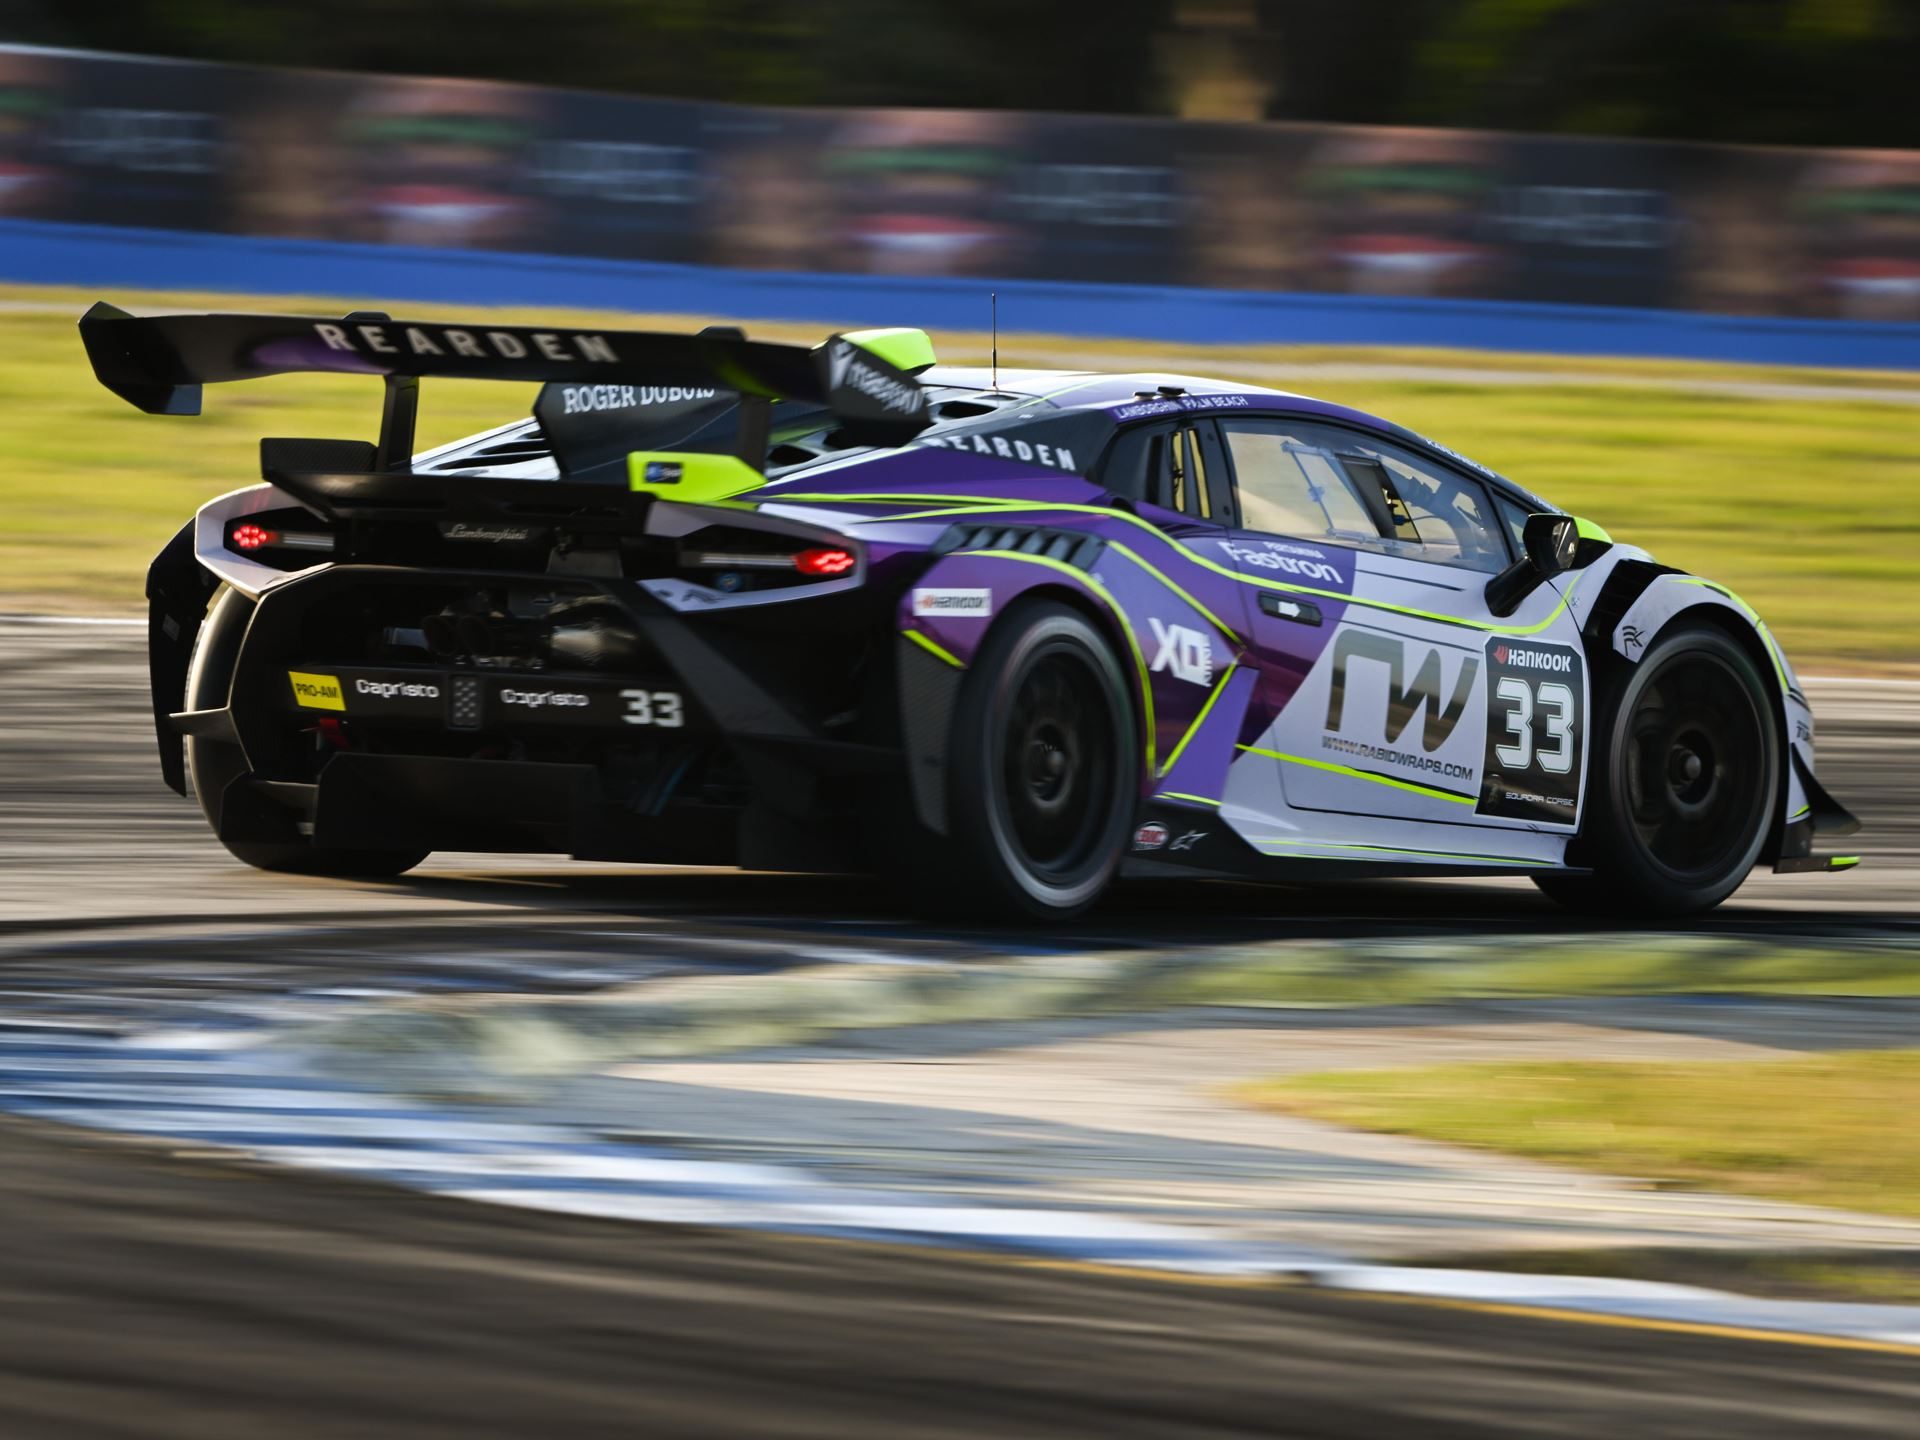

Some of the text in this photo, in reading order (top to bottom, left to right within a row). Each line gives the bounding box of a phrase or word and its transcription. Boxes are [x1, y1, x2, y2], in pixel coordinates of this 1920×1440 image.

[314, 323, 618, 362] REARDEN
[562, 385, 637, 414] ROGER
[1215, 396, 1248, 407] BEACH
[1217, 541, 1344, 584] Fastron
[295, 683, 339, 698] PRO-AM
[356, 679, 439, 698] Capristo
[501, 689, 589, 707] Capristo
[619, 689, 684, 727] 33
[1495, 676, 1574, 774] 33
[1322, 736, 1474, 781] WWW.RABIDWRAPS.COM
